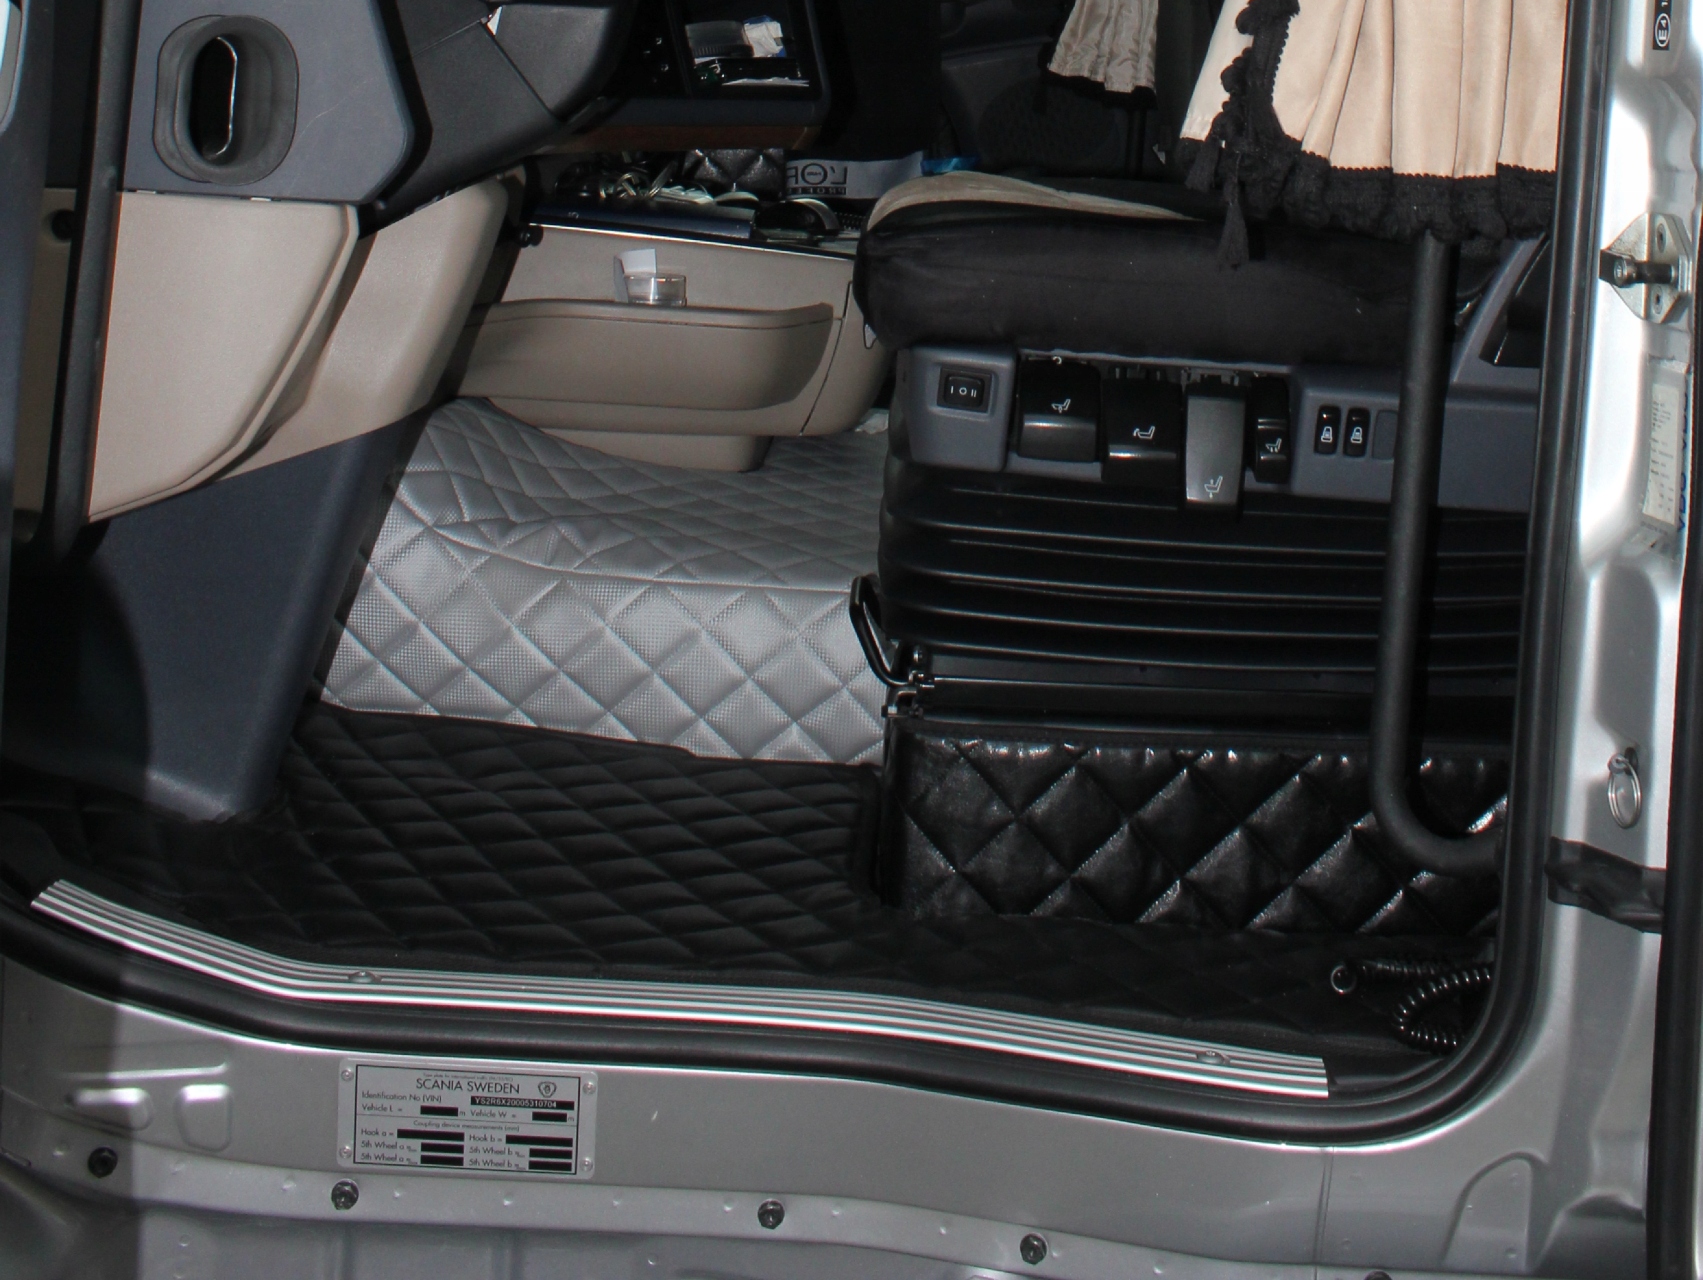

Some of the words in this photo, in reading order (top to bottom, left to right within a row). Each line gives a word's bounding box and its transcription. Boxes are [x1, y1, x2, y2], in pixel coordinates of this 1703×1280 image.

[416, 1078, 463, 1091] SCANIA
[467, 1081, 520, 1094] SWEDEN
[362, 1090, 407, 1101] Identification
[409, 1094, 421, 1102] No
[422, 1095, 442, 1103] (VIN)
[362, 1104, 387, 1112] Vehicle
[470, 1109, 496, 1118] Vehicle
[413, 1120, 440, 1128] Coupling
[361, 1128, 379, 1136] Hook
[469, 1134, 487, 1142] Hook
[360, 1140, 372, 1149] 5th
[374, 1141, 397, 1150] Wheel
[469, 1147, 480, 1155] 5th
[482, 1147, 505, 1156] Wheel
[360, 1153, 372, 1161] 5th
[373, 1154, 397, 1162] Wheel
[482, 1159, 505, 1167] Wheel
